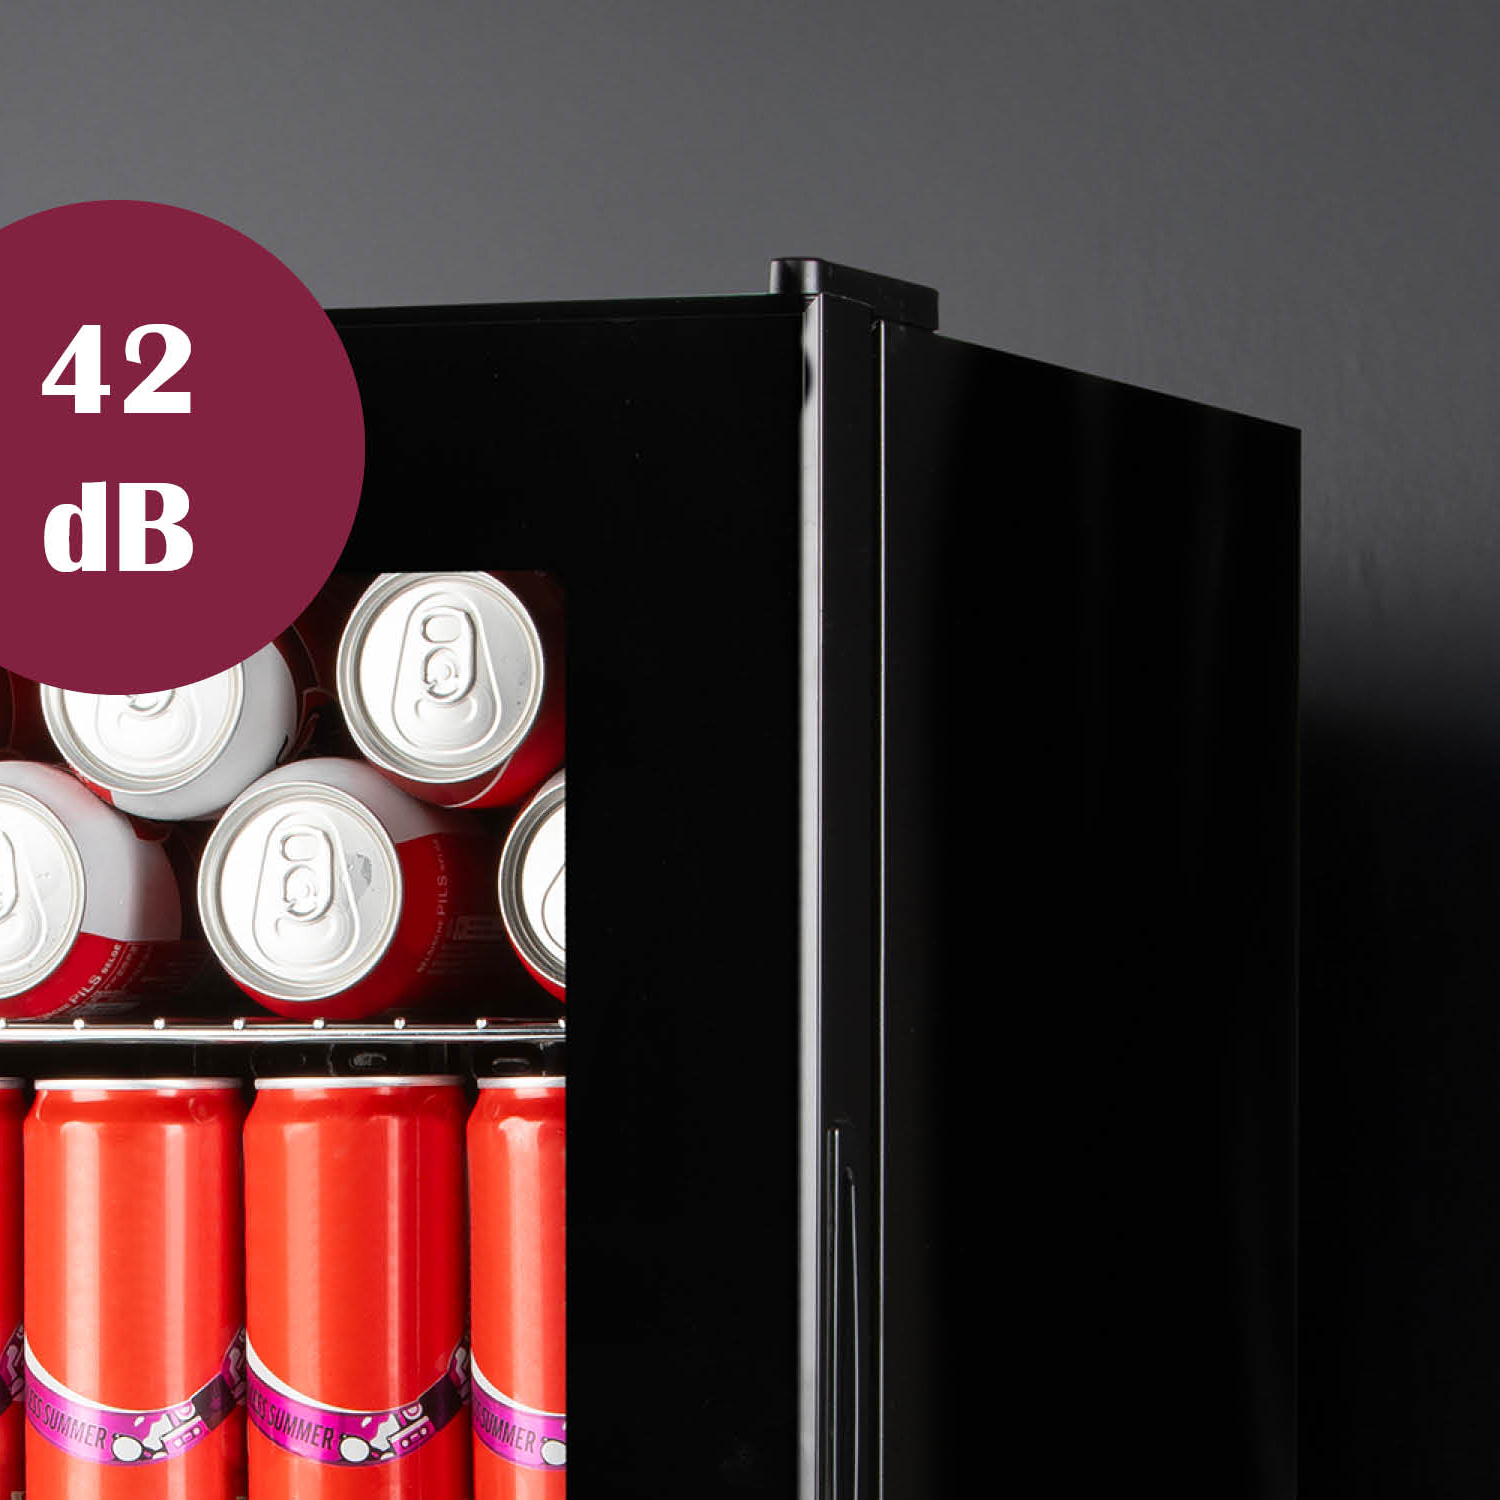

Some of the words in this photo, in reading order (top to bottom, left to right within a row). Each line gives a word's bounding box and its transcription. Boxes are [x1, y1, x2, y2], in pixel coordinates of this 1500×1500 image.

[67, 974, 102, 1005] PILS
[43, 1403, 108, 1450] SUMMER
[267, 1404, 334, 1450] SUMMER
[481, 1407, 537, 1454] SUMMER
